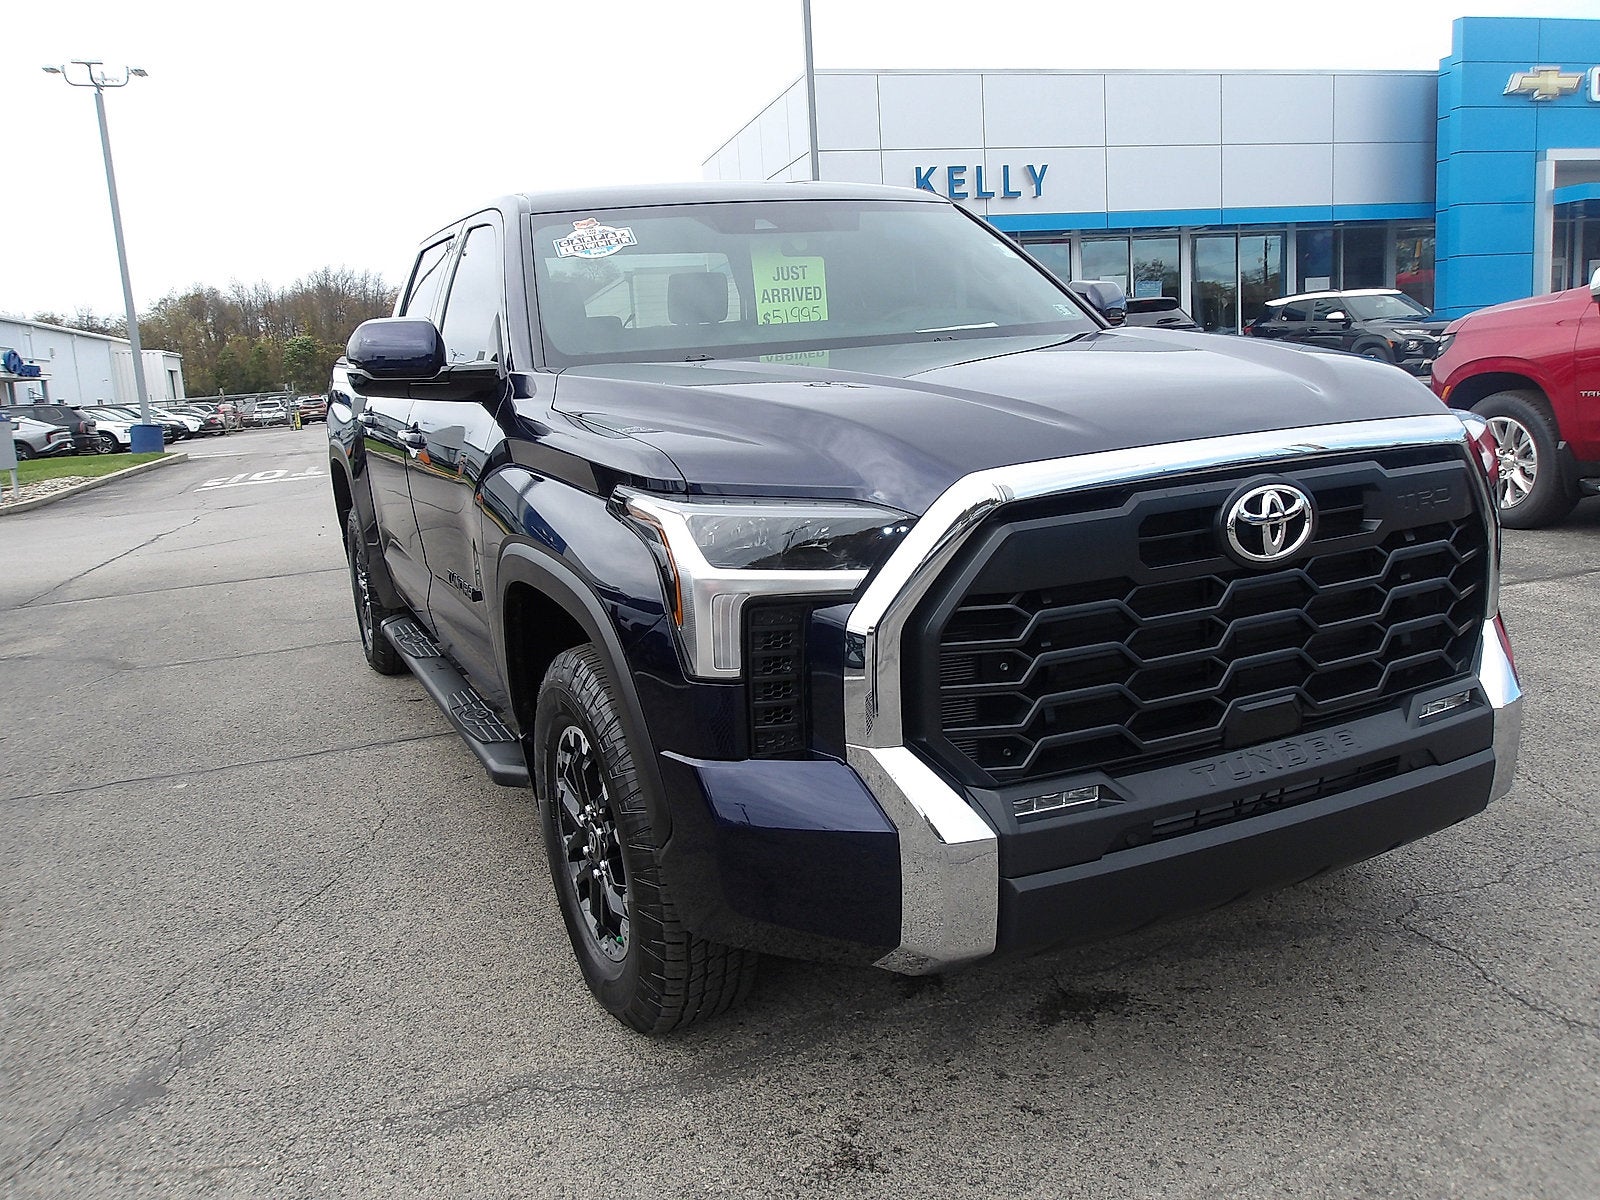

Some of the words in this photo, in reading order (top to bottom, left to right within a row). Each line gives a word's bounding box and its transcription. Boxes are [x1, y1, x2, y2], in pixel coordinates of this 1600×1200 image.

[914, 164, 1048, 199] KELLY
[772, 265, 808, 281] JUST
[761, 286, 822, 304] ARRIVED
[763, 305, 821, 325] $51995
[1188, 729, 1362, 787] TUNDRA
